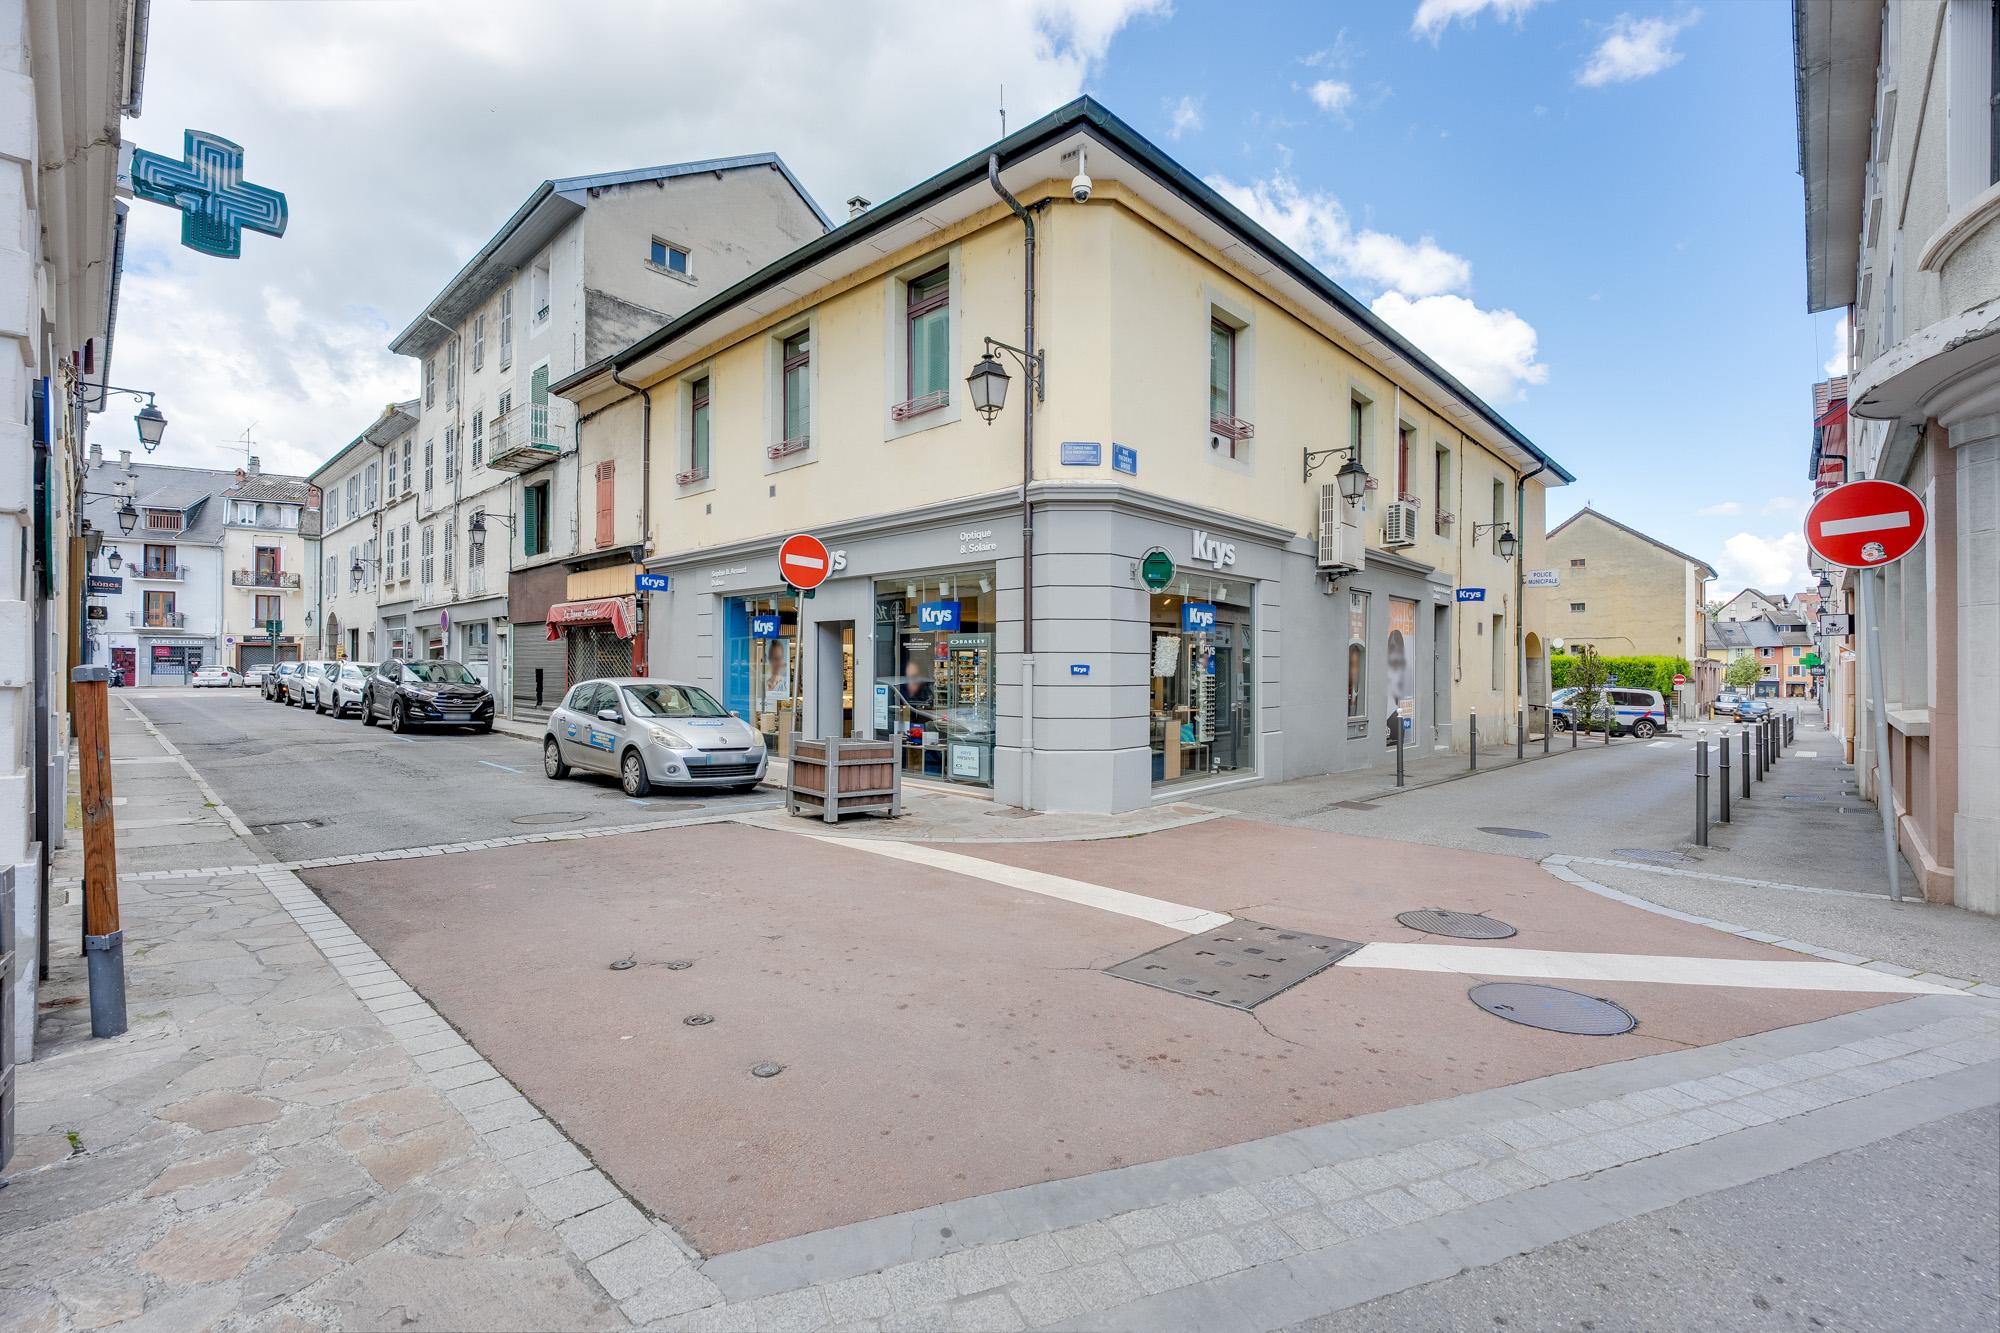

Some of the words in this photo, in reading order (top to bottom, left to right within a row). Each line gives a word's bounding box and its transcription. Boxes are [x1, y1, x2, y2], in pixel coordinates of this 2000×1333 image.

[960, 529, 992, 541] Optique
[960, 544, 968, 553] &
[969, 542, 997, 553] Solaire
[1192, 529, 1236, 569] Krys
[641, 576, 665, 588] Krys
[1460, 590, 1481, 599] Krys
[922, 607, 952, 626] Krys
[1189, 607, 1213, 627] Krys
[754, 620, 774, 634] Krys
